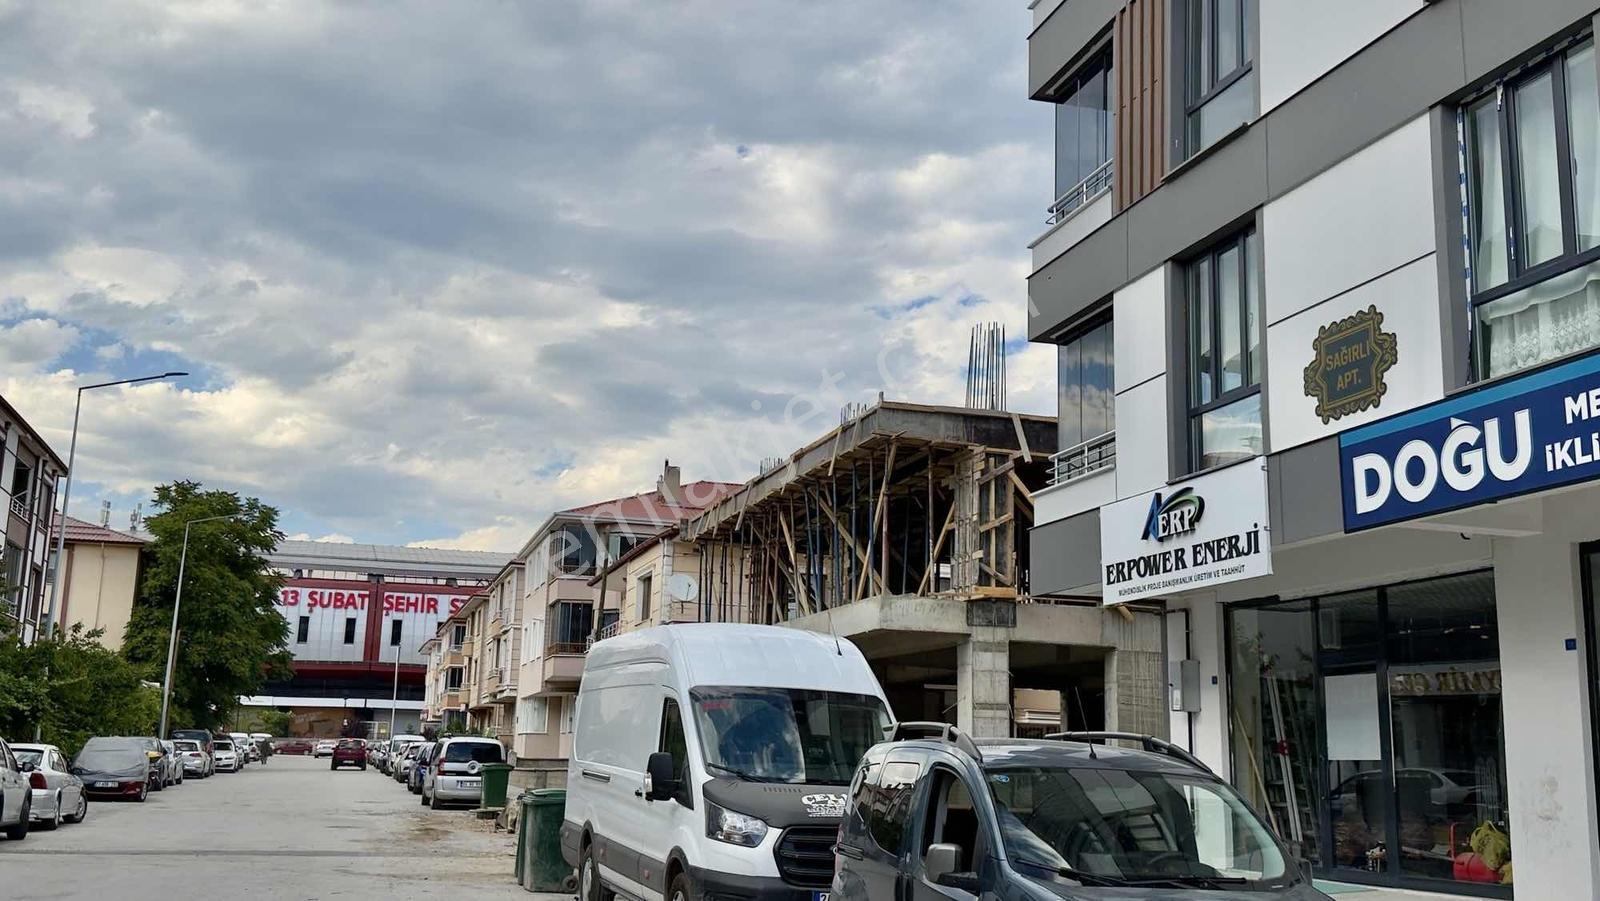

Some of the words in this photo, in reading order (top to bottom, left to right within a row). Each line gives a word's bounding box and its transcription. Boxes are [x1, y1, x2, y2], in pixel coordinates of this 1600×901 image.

[1336, 368, 1362, 391] APT.
[1352, 408, 1533, 514] DOĞU
[1106, 547, 1188, 585] ERPOWER
[1192, 522, 1260, 567] ENERJİ
[1147, 581, 1162, 592] PROJE
[1213, 570, 1220, 578] VE
[281, 588, 300, 607] 13
[307, 589, 369, 613] ŞUBAT
[383, 593, 439, 617] ŞEHİR
